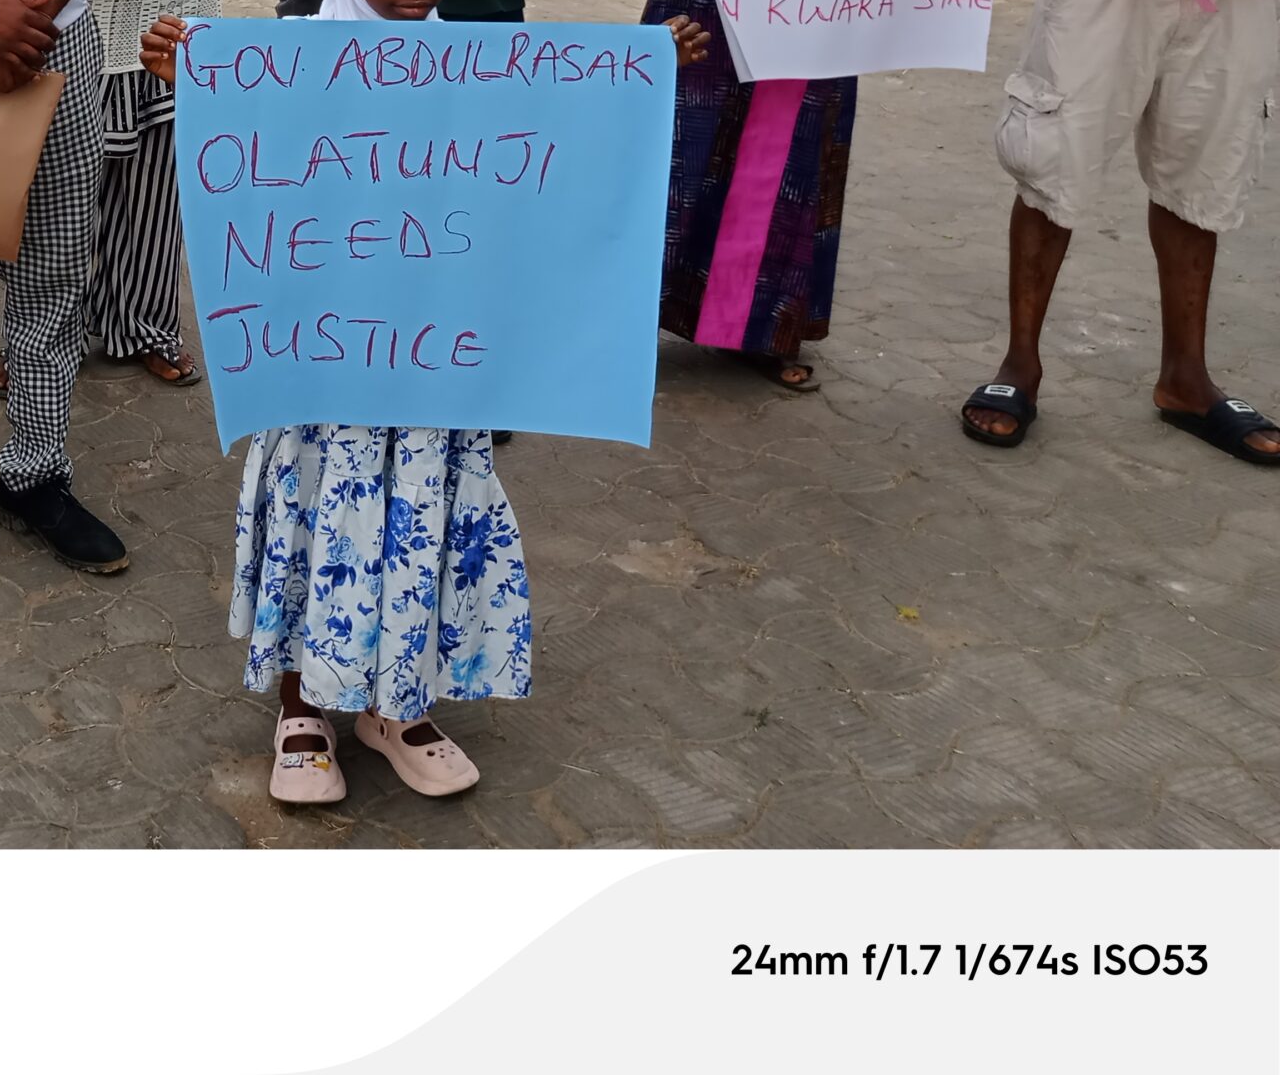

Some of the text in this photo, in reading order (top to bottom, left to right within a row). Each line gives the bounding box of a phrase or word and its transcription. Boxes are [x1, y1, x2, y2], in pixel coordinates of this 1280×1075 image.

[184, 23, 653, 94] GOV. ABDULRASAK
[198, 131, 555, 194] OLATUNJI
[223, 210, 472, 292] NEEDS
[207, 303, 488, 372] JUSTICE
